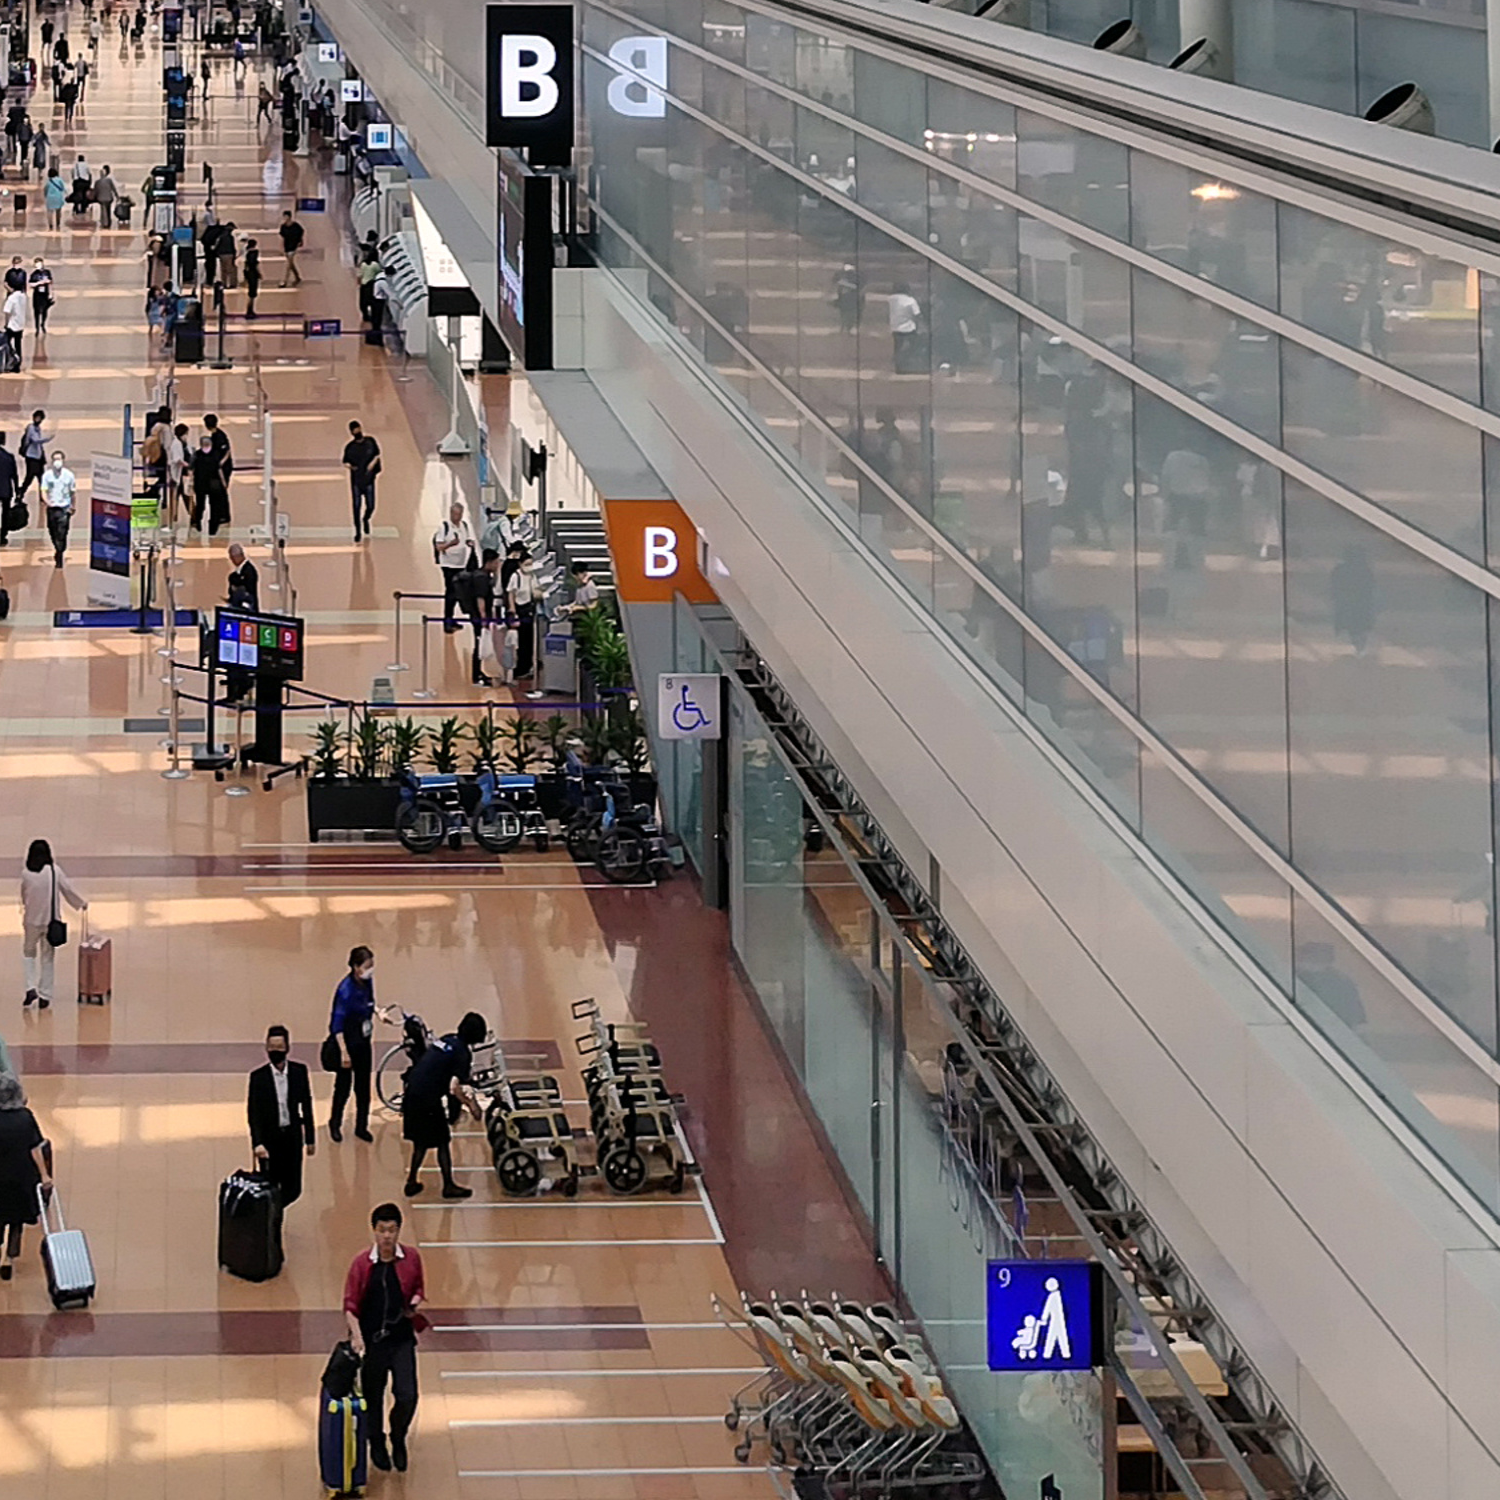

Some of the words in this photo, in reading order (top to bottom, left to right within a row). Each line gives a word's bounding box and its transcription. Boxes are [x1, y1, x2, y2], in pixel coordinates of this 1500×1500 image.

[501, 34, 559, 117] B
[644, 526, 679, 577] B
[225, 623, 232, 632] A
[264, 629, 271, 638] C
[284, 632, 292, 642] D
[998, 1268, 1012, 1288] 9
